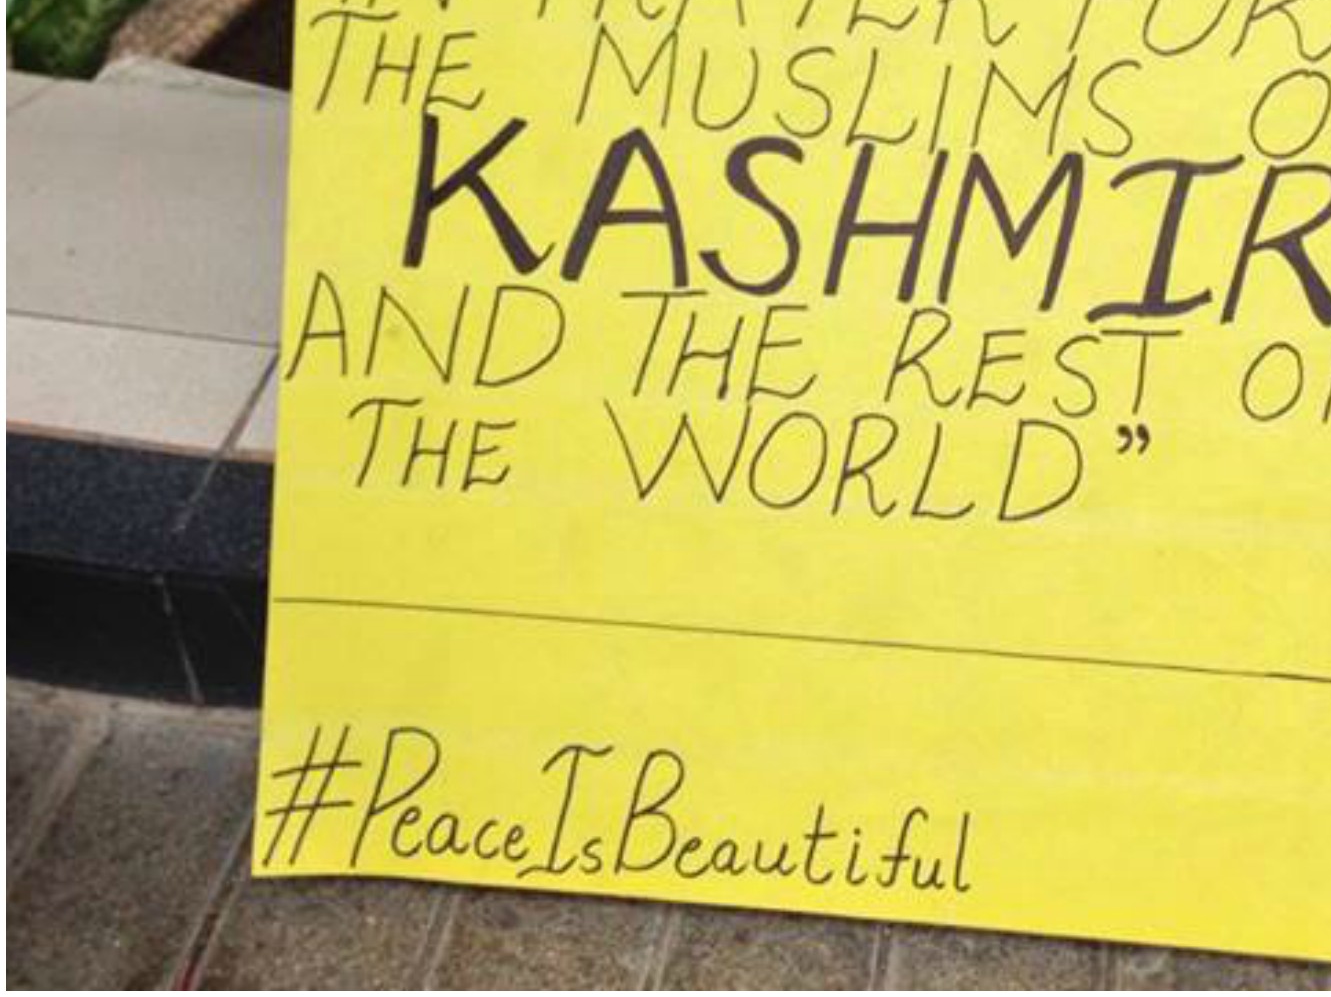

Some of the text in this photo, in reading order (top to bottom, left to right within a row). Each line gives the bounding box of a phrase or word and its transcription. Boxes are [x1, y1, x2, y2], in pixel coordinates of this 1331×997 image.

[311, 10, 487, 113] THE
[575, 24, 1144, 160] MUSLIMS
[285, 272, 567, 389] AND
[621, 290, 819, 402] THE
[885, 308, 1182, 417] REST
[349, 399, 516, 494] THE
[264, 724, 971, 895] #PeaceIsBeautiful
